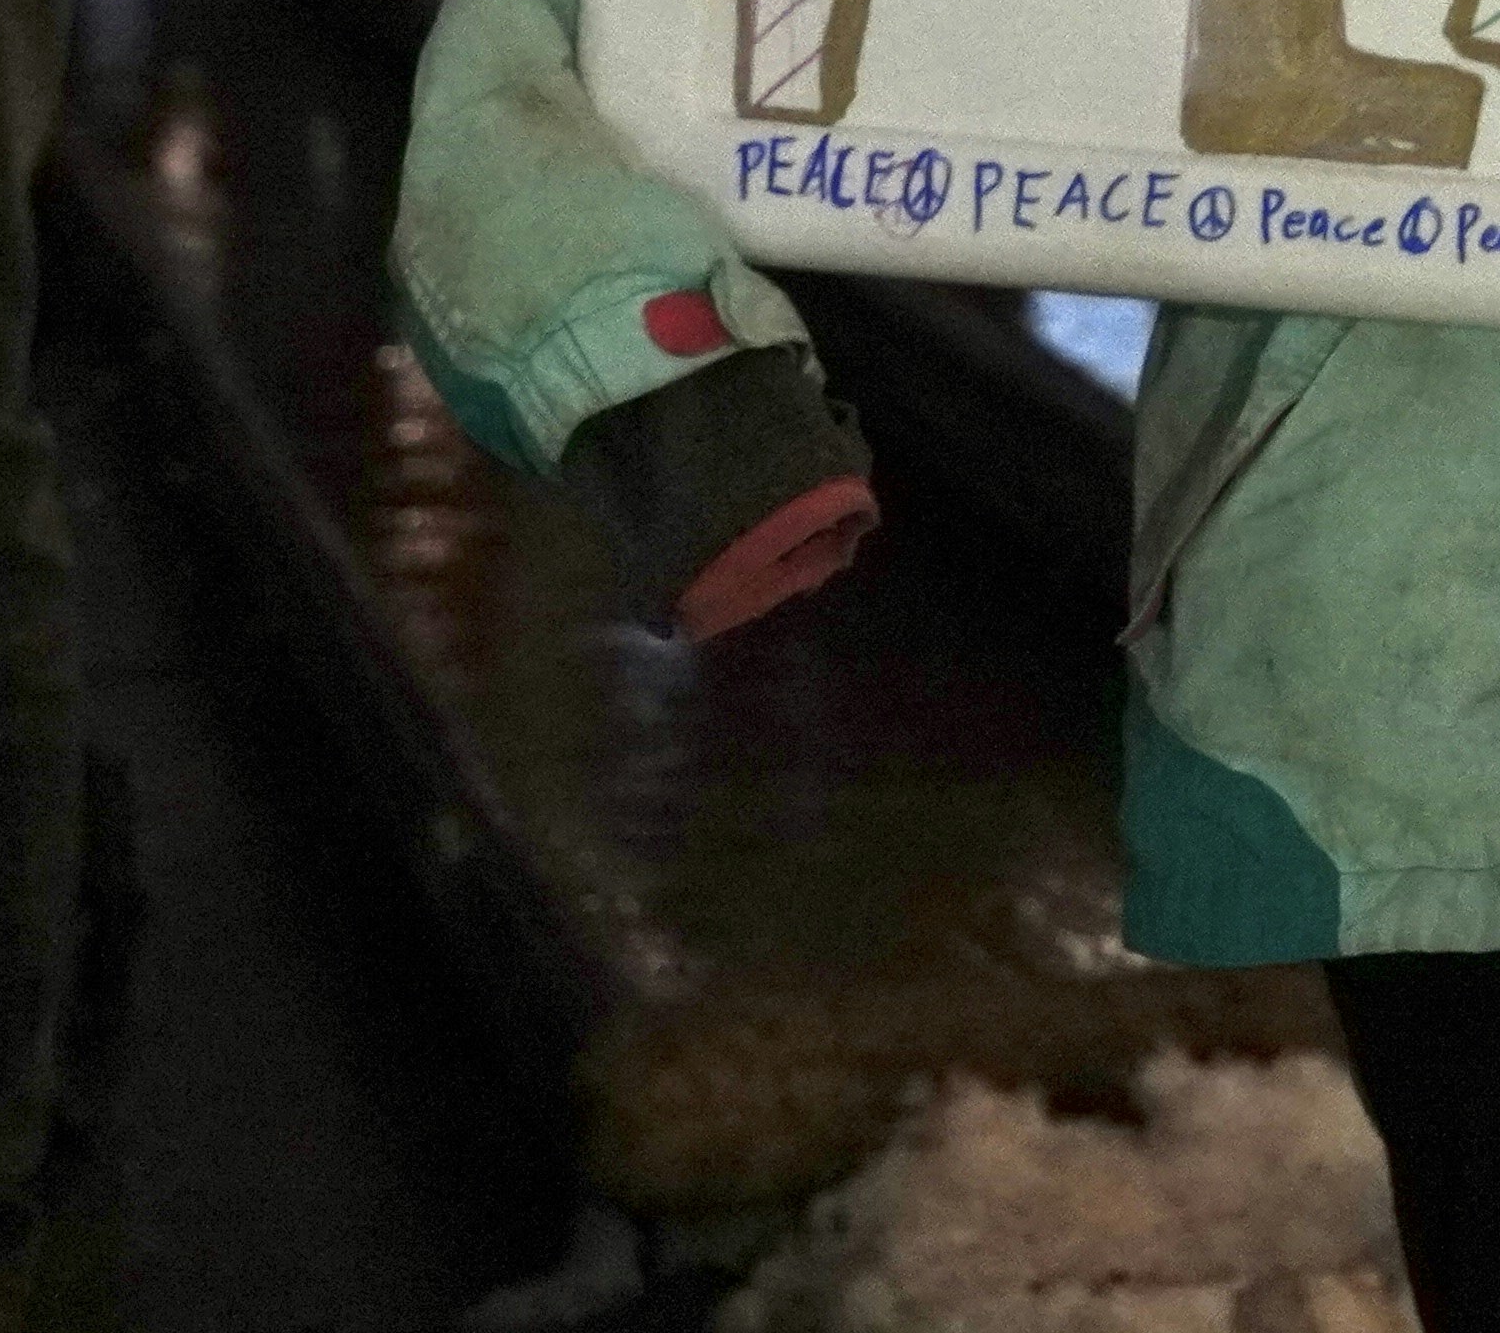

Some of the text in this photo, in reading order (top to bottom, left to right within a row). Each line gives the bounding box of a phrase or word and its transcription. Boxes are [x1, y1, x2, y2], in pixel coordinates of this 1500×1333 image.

[737, 135, 895, 210] PEACE
[973, 162, 1181, 230] PEACE
[1260, 189, 1388, 246] Peace
